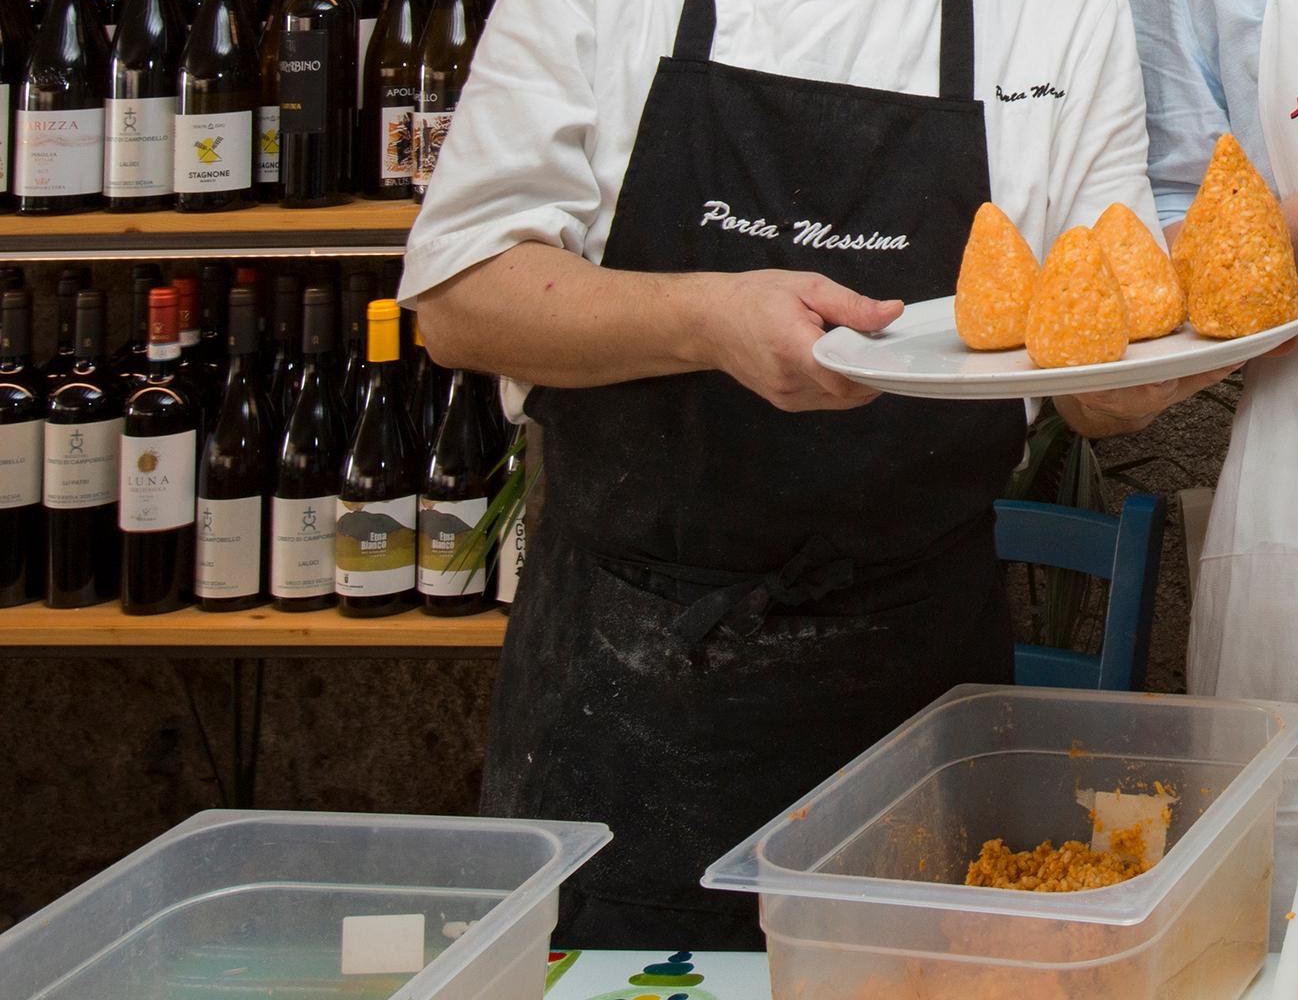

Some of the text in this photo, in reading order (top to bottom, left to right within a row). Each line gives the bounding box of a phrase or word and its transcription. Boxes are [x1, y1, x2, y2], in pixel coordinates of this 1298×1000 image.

[387, 88, 415, 97] APOLL
[189, 170, 230, 179] STAGNONE
[700, 200, 910, 250] Porta Messina
[128, 475, 169, 486] LUNA
[370, 532, 387, 542] Etna
[440, 531, 455, 542] Etna
[361, 540, 388, 551] Bianco
[432, 539, 455, 550] Bianco
